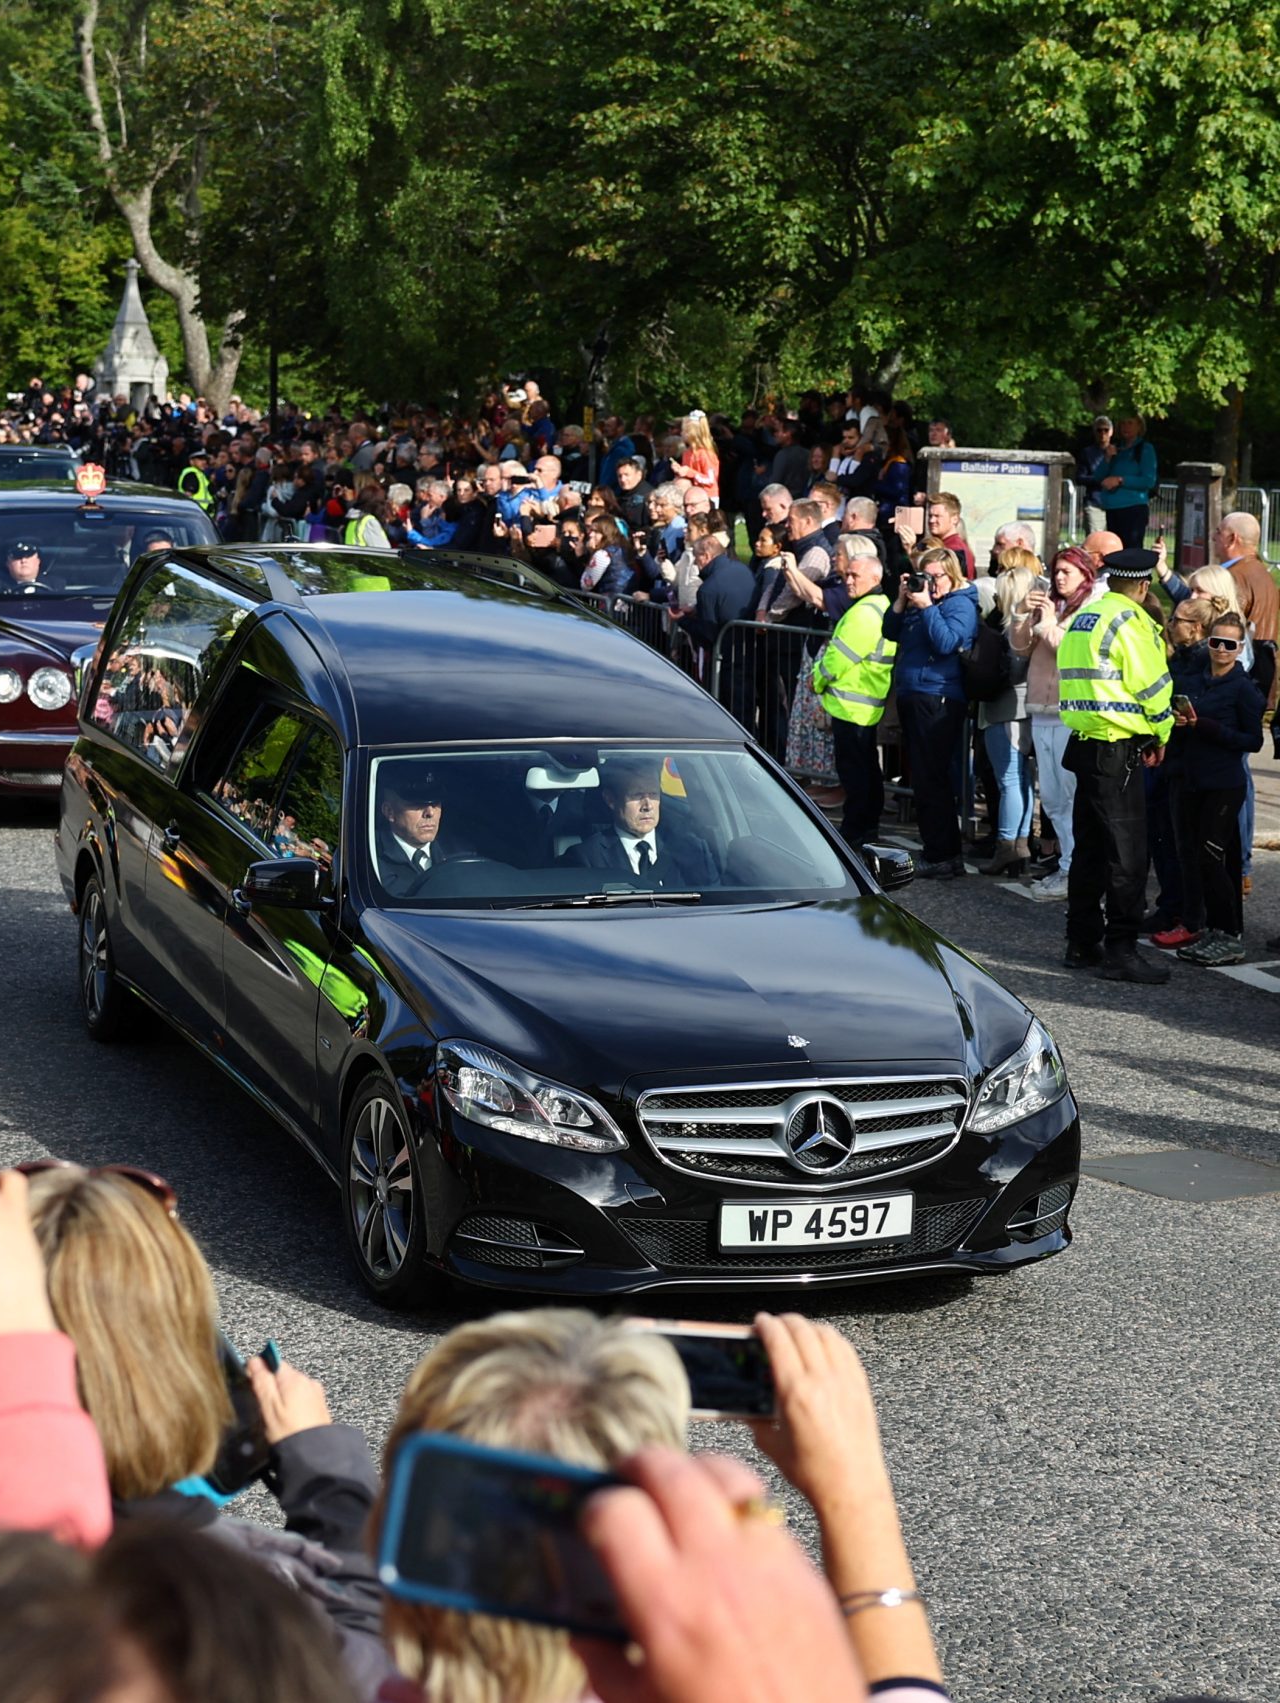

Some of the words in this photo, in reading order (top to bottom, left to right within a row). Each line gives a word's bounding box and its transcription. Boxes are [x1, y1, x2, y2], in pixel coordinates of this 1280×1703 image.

[961, 462, 1000, 472] Ballater
[1001, 463, 1031, 474] Paths
[748, 1210, 793, 1241] WP
[804, 1202, 891, 1239] 4597
